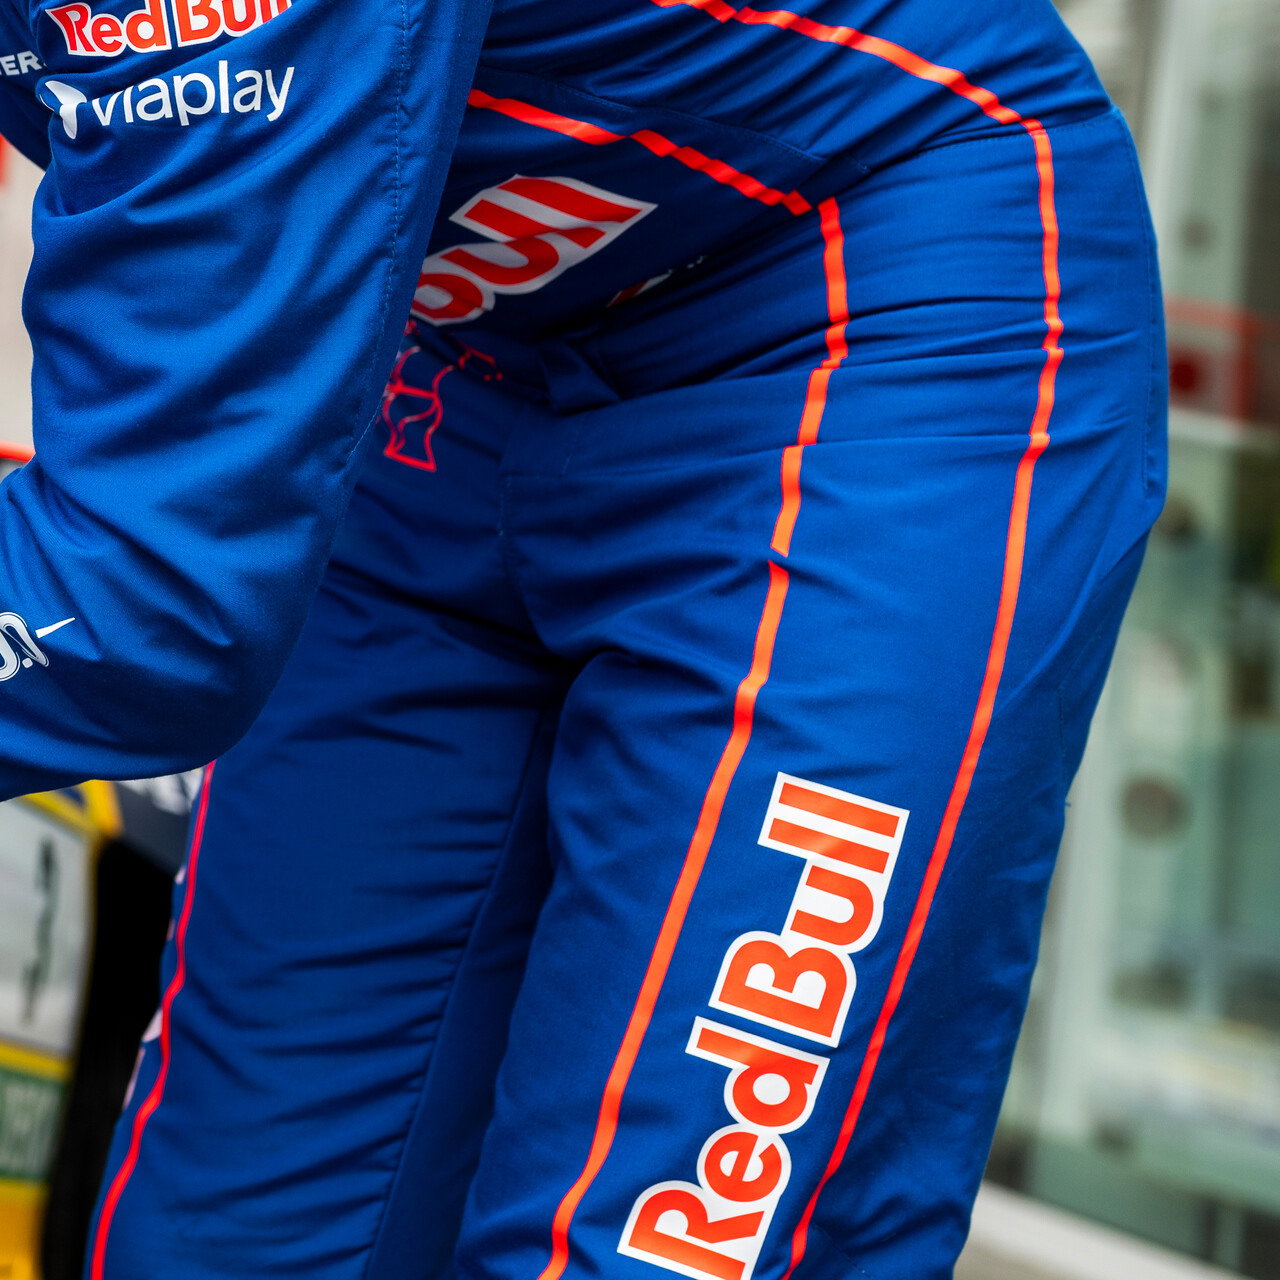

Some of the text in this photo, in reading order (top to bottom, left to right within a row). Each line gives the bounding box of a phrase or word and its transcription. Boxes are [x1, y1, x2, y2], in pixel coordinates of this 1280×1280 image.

[92, 60, 295, 126] viaplay
[617, 771, 911, 1280] Red Bull
